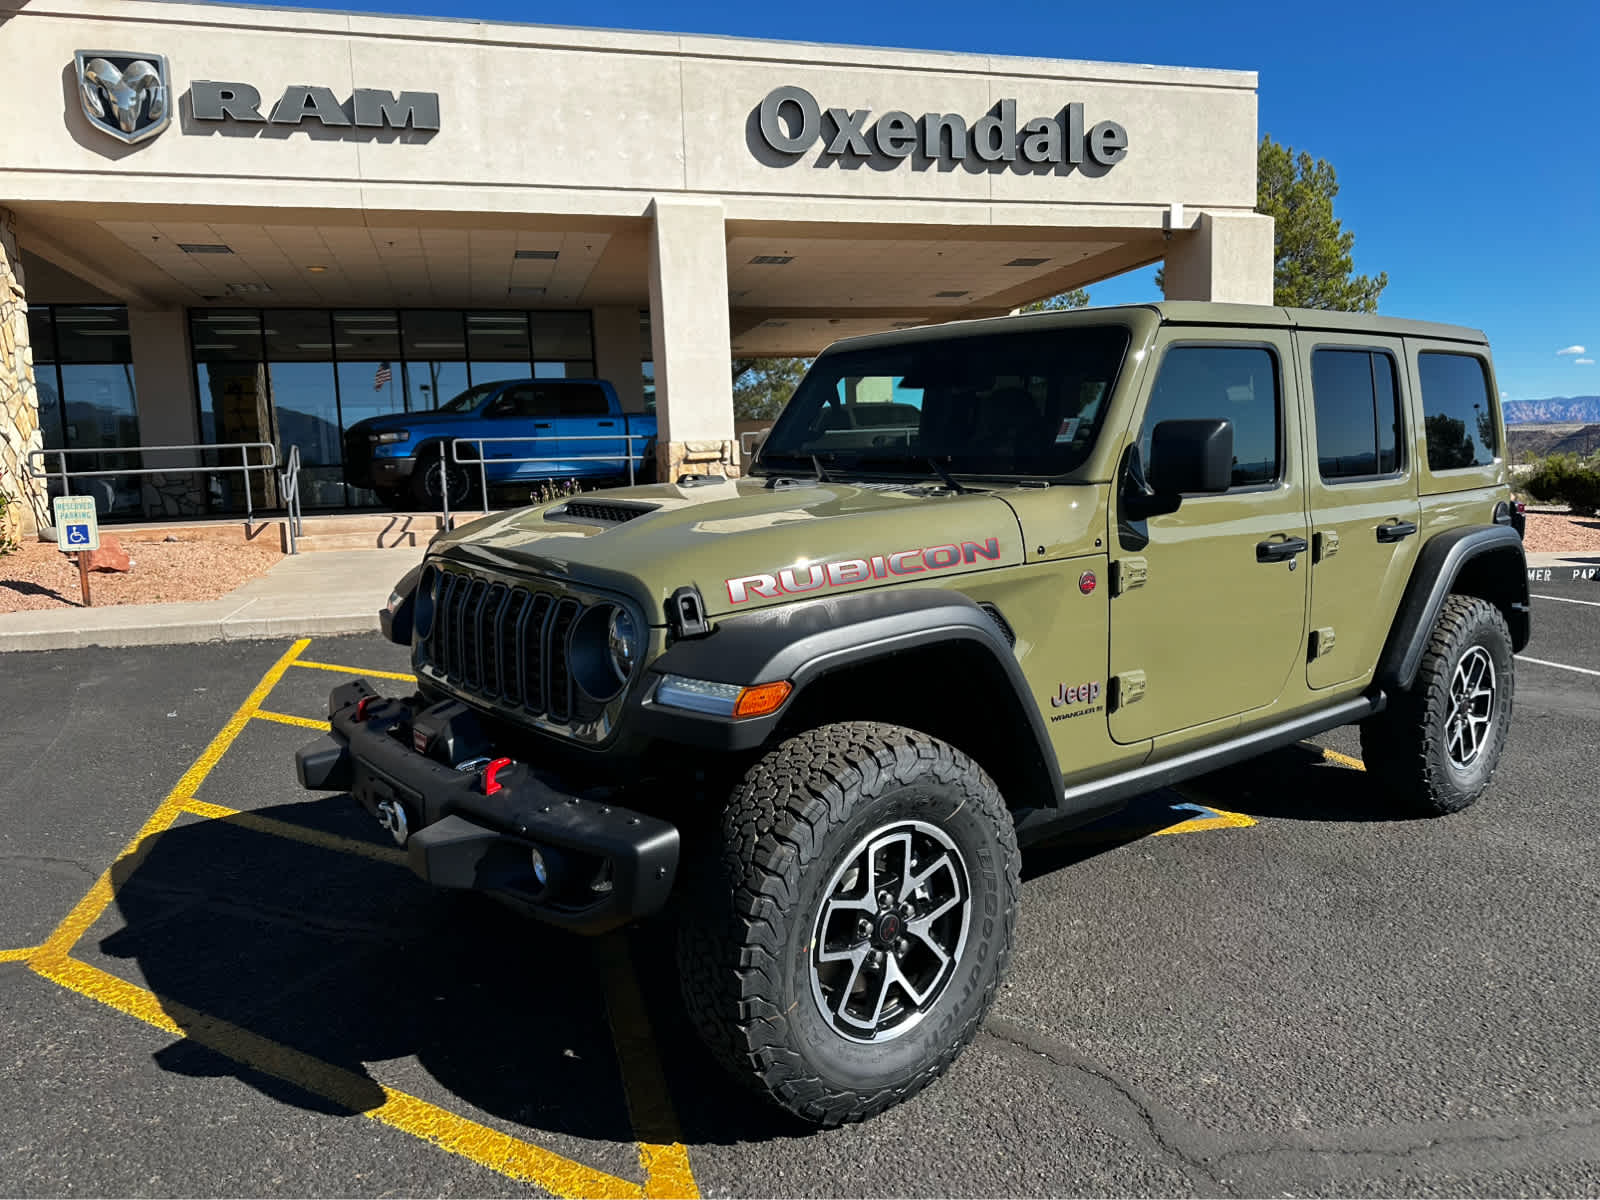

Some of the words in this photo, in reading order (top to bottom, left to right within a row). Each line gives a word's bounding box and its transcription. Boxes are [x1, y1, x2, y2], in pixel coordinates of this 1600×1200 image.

[190, 79, 440, 130] RAM
[760, 85, 1128, 165] Oxendale
[725, 537, 1000, 604] RUBICON
[1572, 568, 1600, 580] PAR
[1051, 681, 1101, 707] Jeep
[1050, 707, 1095, 722] WRANGLER
